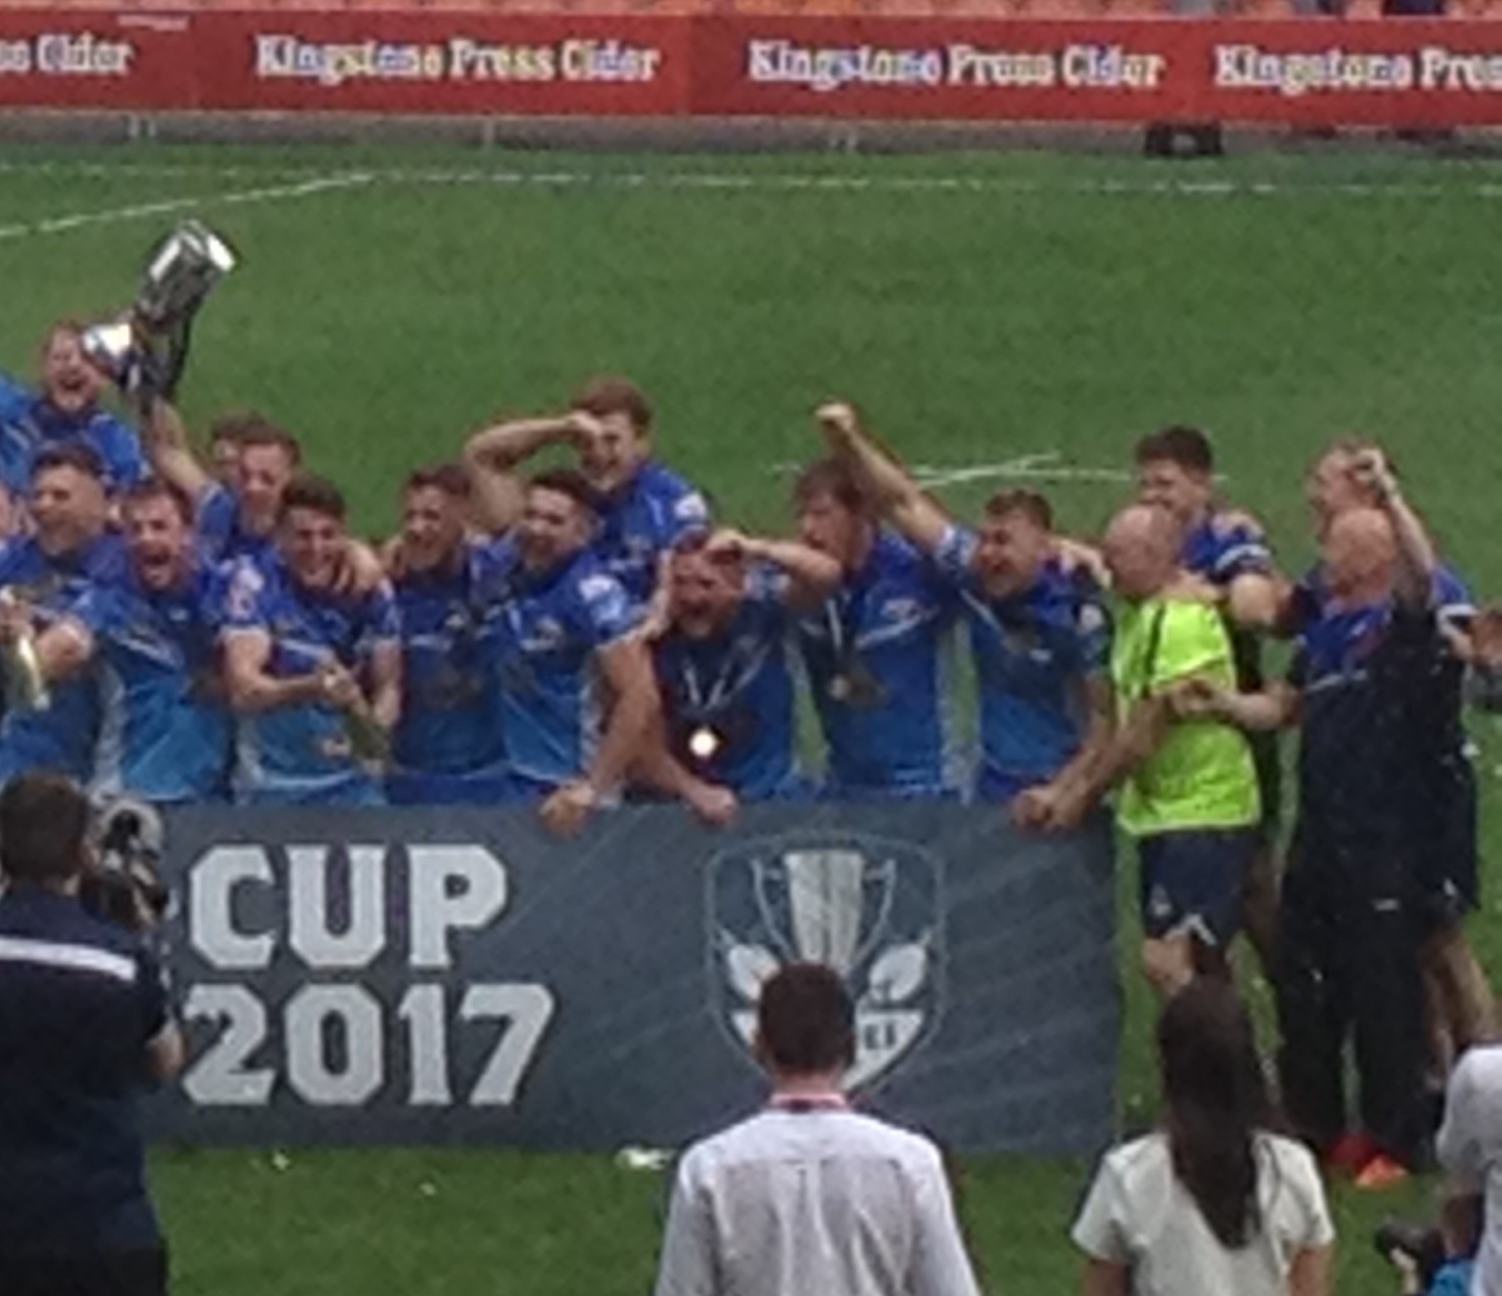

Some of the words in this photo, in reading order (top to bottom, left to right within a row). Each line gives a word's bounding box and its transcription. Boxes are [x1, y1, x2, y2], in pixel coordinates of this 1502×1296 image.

[36, 32, 133, 73] Cider
[255, 34, 444, 84] Kingstone
[450, 38, 555, 80] Press
[561, 39, 659, 81] Cider
[749, 40, 942, 90] Kingstone
[948, 44, 1054, 87] Press
[1061, 45, 1166, 88] Cider
[1215, 45, 1412, 95] Kingstone
[189, 844, 508, 969] CUP
[182, 983, 554, 1106] 2017
